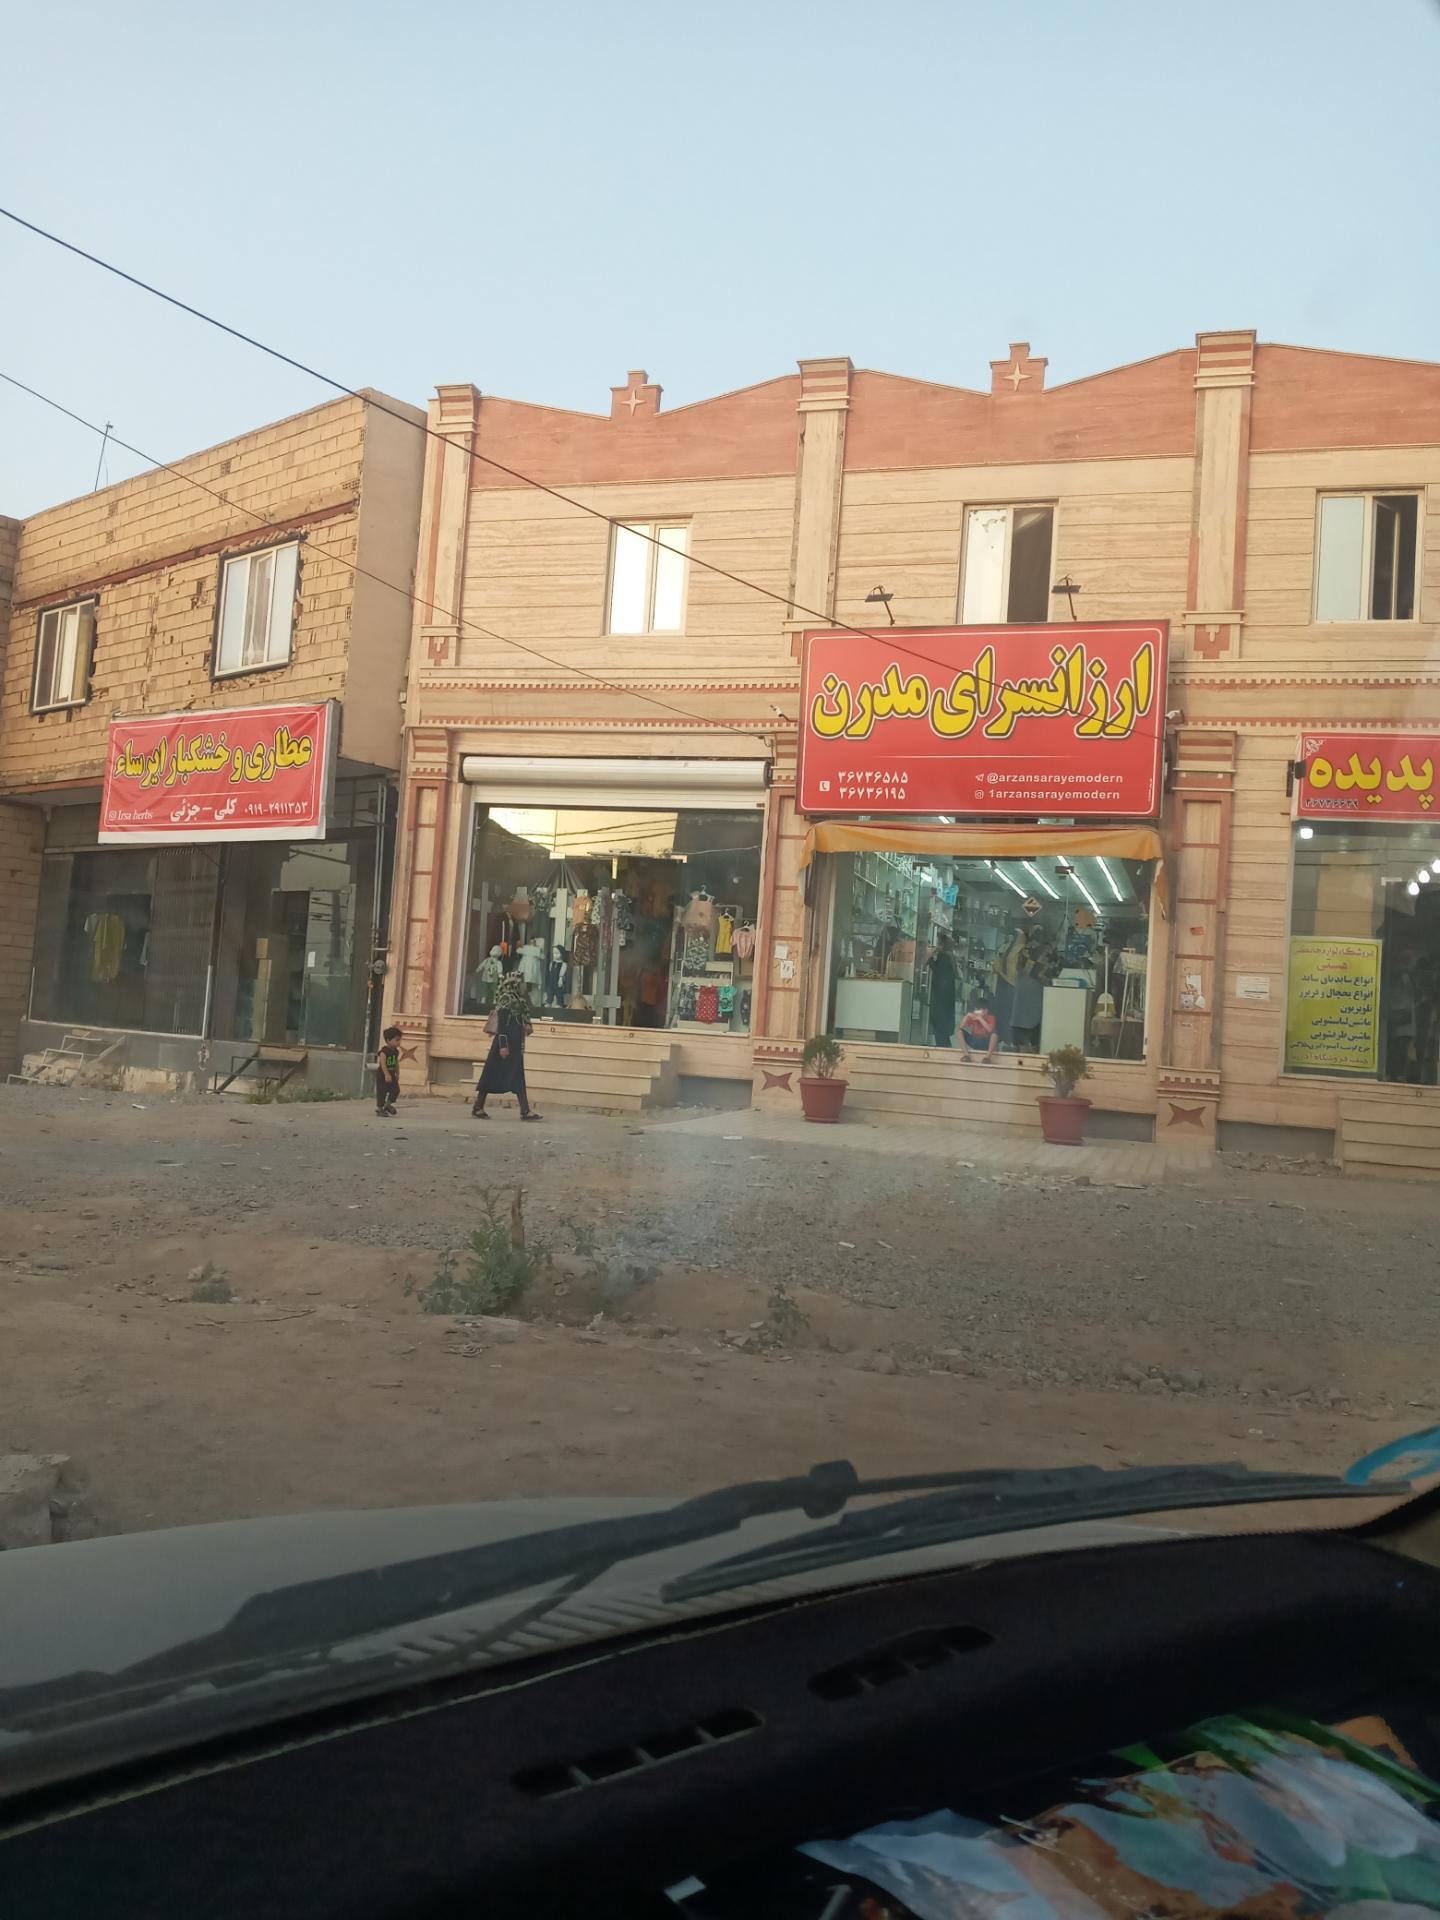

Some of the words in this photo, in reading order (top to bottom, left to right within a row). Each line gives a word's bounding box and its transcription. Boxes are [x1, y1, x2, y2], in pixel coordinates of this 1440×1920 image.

[811, 662, 929, 740] مدرن
[930, 642, 1153, 740] ارزانسرای
[165, 733, 230, 788] خشکبار
[229, 747, 243, 783] و
[245, 726, 312, 782] عطاری
[838, 771, 908, 784] ۳۶۷۳۶۵۸۵
[987, 772, 1123, 784] @arzansarayemodern
[1308, 752, 1435, 811] پدیده
[839, 787, 906, 800] ۳۶۷۳۶۱۹۵
[989, 789, 1120, 800] 1arzansarayemodern
[170, 798, 200, 822] جزئی
[213, 797, 238, 821] کلی
